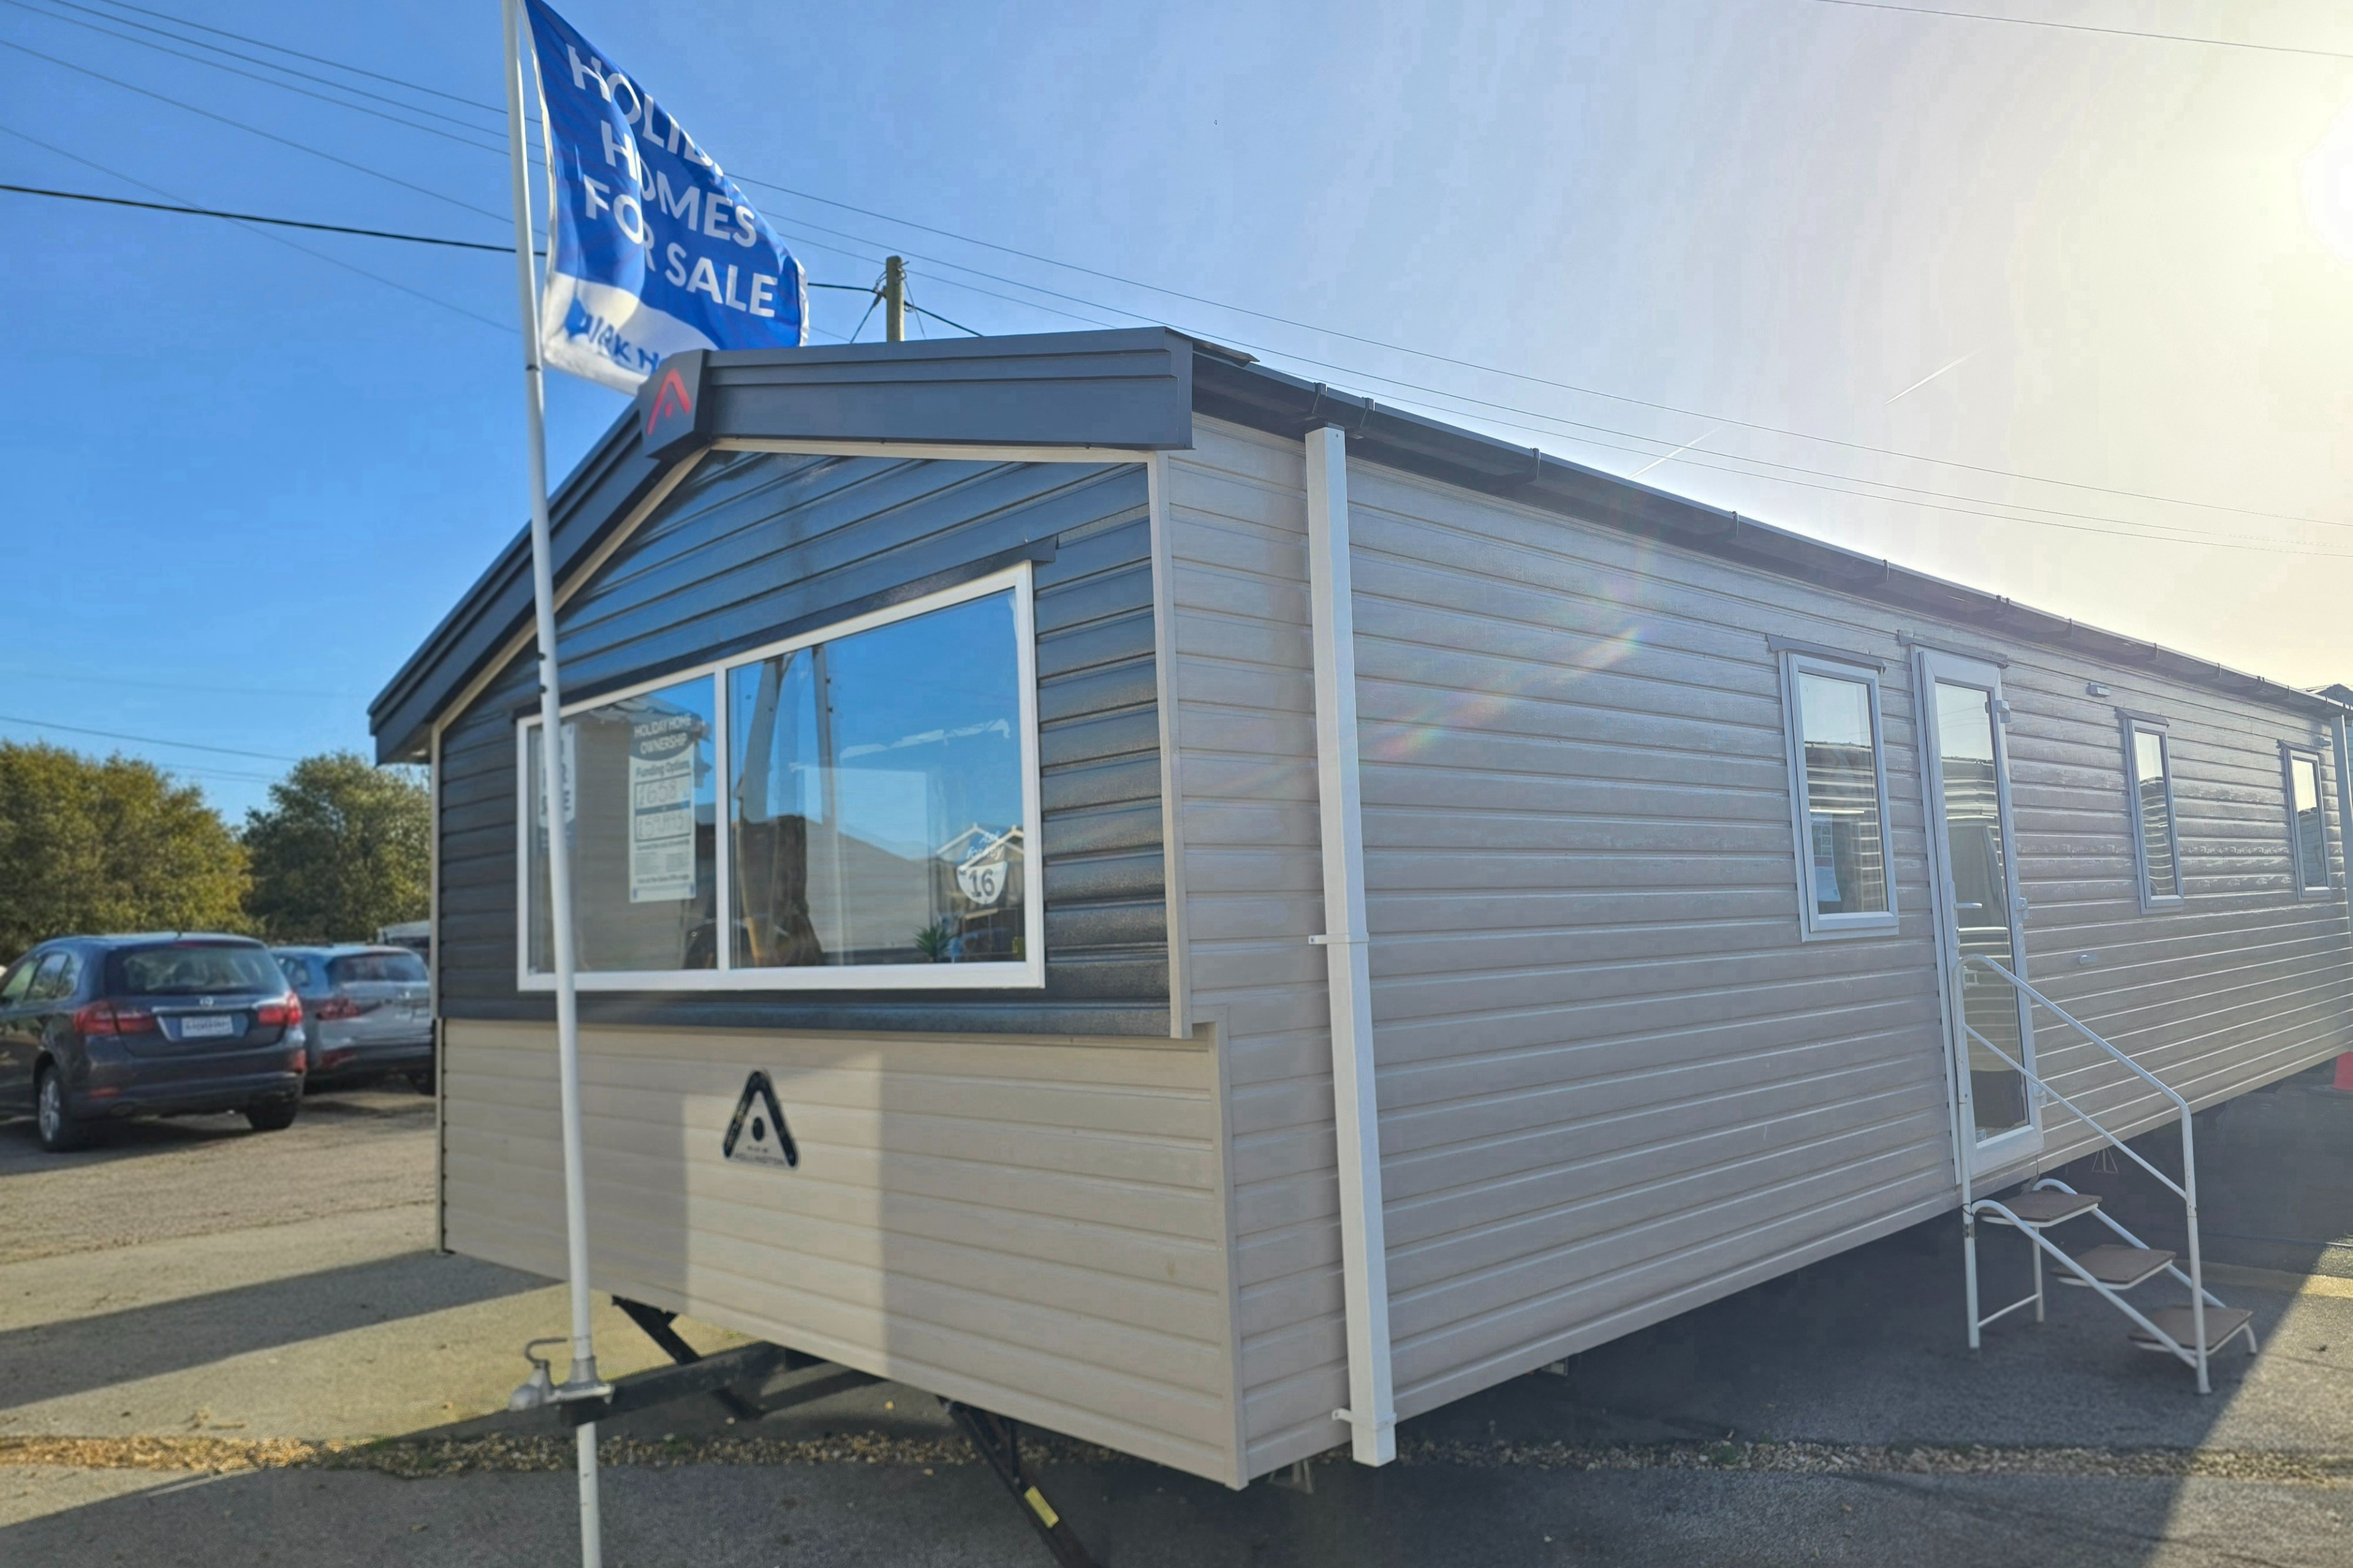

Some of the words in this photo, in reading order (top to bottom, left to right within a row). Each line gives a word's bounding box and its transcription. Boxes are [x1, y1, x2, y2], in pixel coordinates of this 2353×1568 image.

[566, 43, 740, 192] HOLID
[601, 119, 757, 248] HOMES
[665, 242, 778, 317] SALE
[634, 719, 667, 738] HOLIDAY
[640, 732, 688, 755] OWNERSHIP
[968, 868, 995, 897] 16
